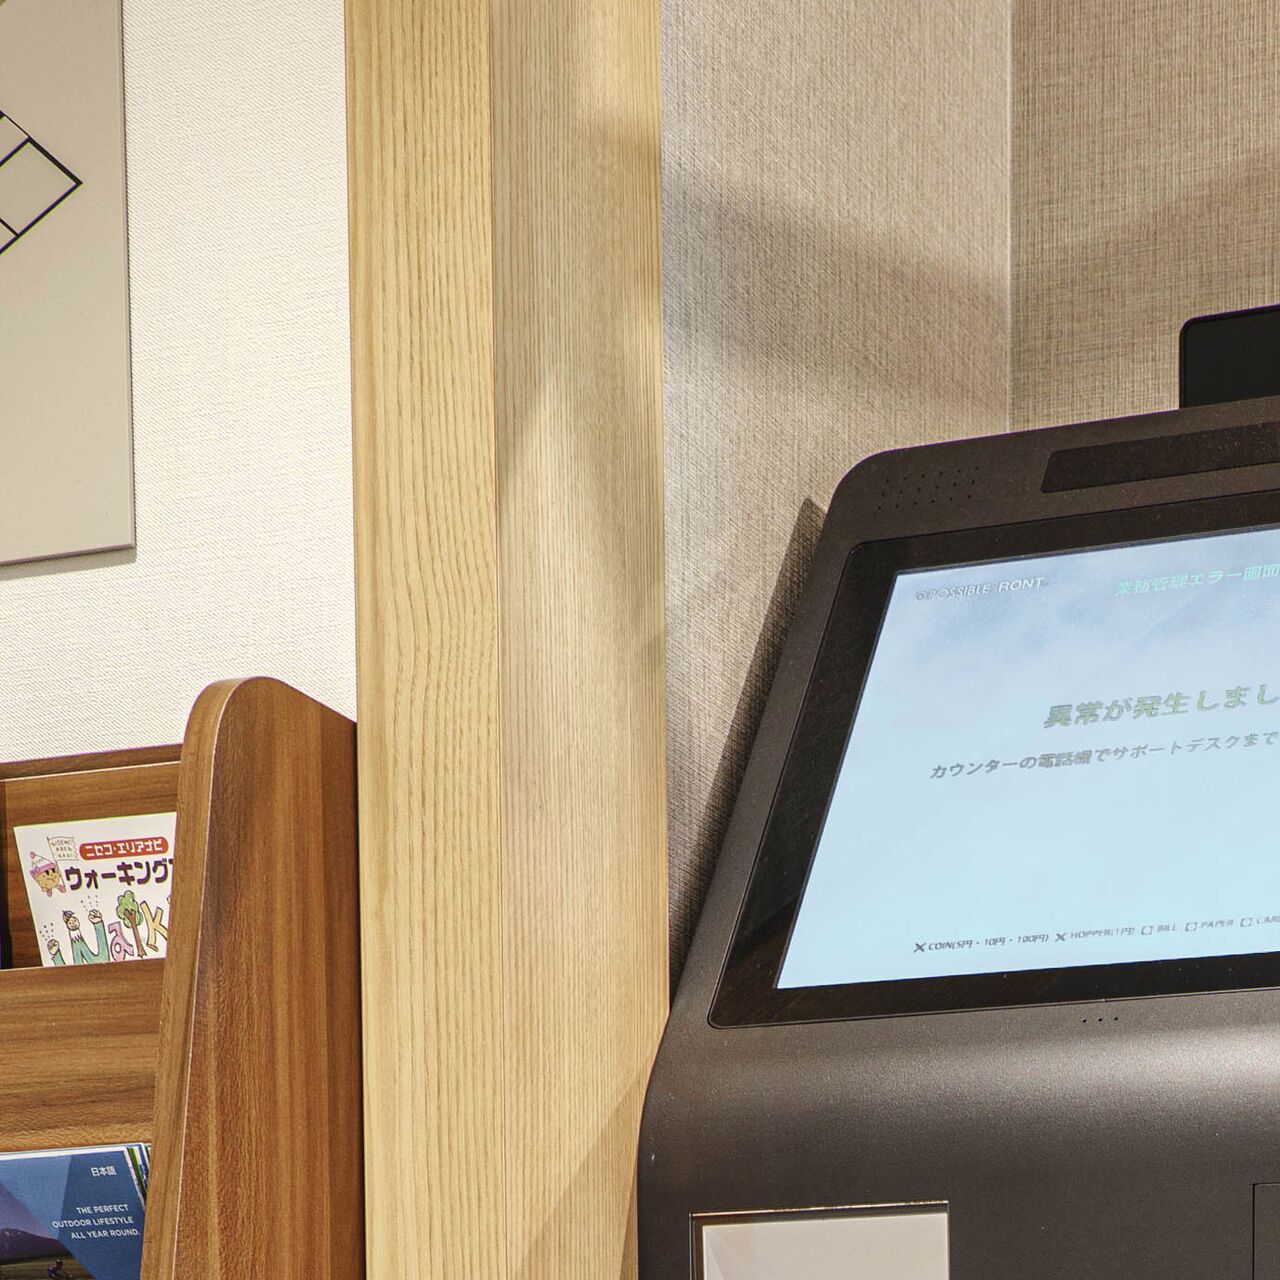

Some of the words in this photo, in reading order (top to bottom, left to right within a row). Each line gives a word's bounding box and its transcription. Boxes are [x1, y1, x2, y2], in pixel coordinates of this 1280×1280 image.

[84, 839, 163, 857] ニセコ・エリアナビ
[64, 857, 173, 890] ウォーキング
[76, 1206, 93, 1214] THE
[93, 1204, 129, 1213] PERFECT
[52, 1219, 92, 1228] OUTDOOR
[92, 1216, 134, 1226] LIFESTYLE
[71, 1231, 87, 1239] ALL
[87, 1229, 109, 1238] YEAR
[110, 1228, 141, 1237] ROUND.
